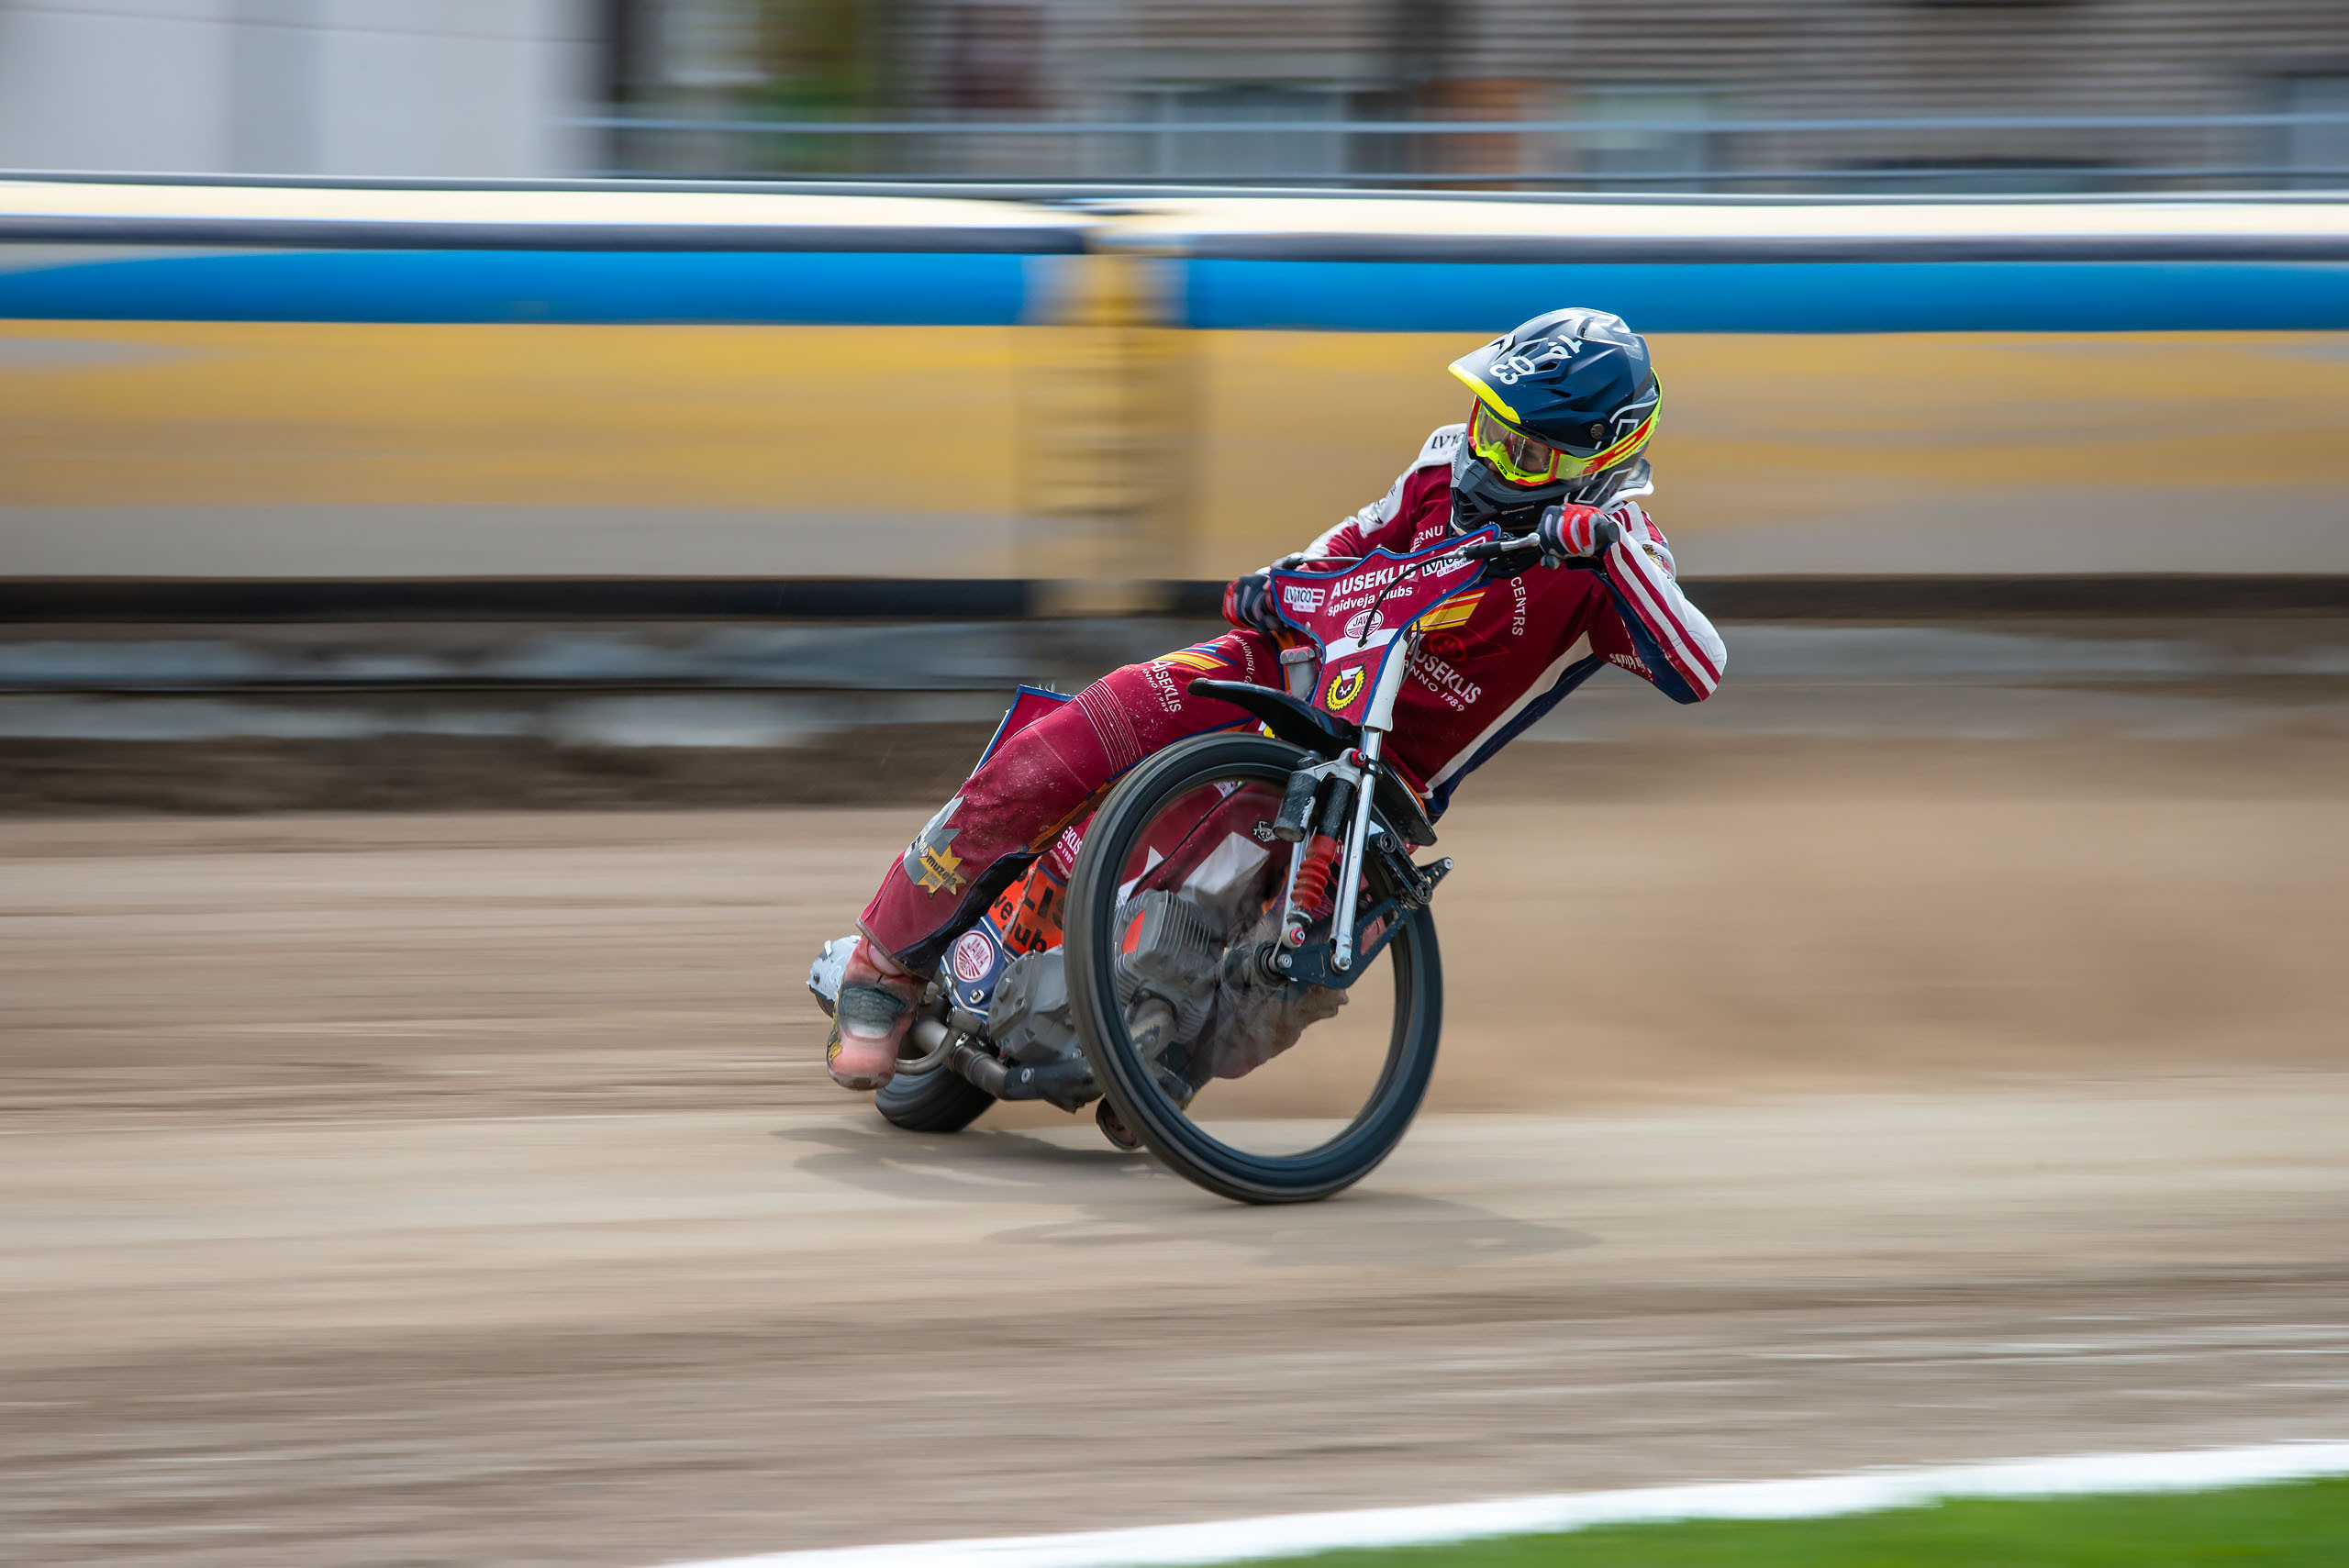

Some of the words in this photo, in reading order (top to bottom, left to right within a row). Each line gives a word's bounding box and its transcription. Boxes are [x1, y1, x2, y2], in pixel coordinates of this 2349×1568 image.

[1328, 593, 1375, 617] spidveja
[1330, 562, 1417, 600] AUSEKLIS
[1510, 576, 1527, 636] CENTRS
[1150, 660, 1182, 713] AUSEKLIS
[1405, 659, 1439, 692] ANNO
[1441, 692, 1465, 712] 1989
